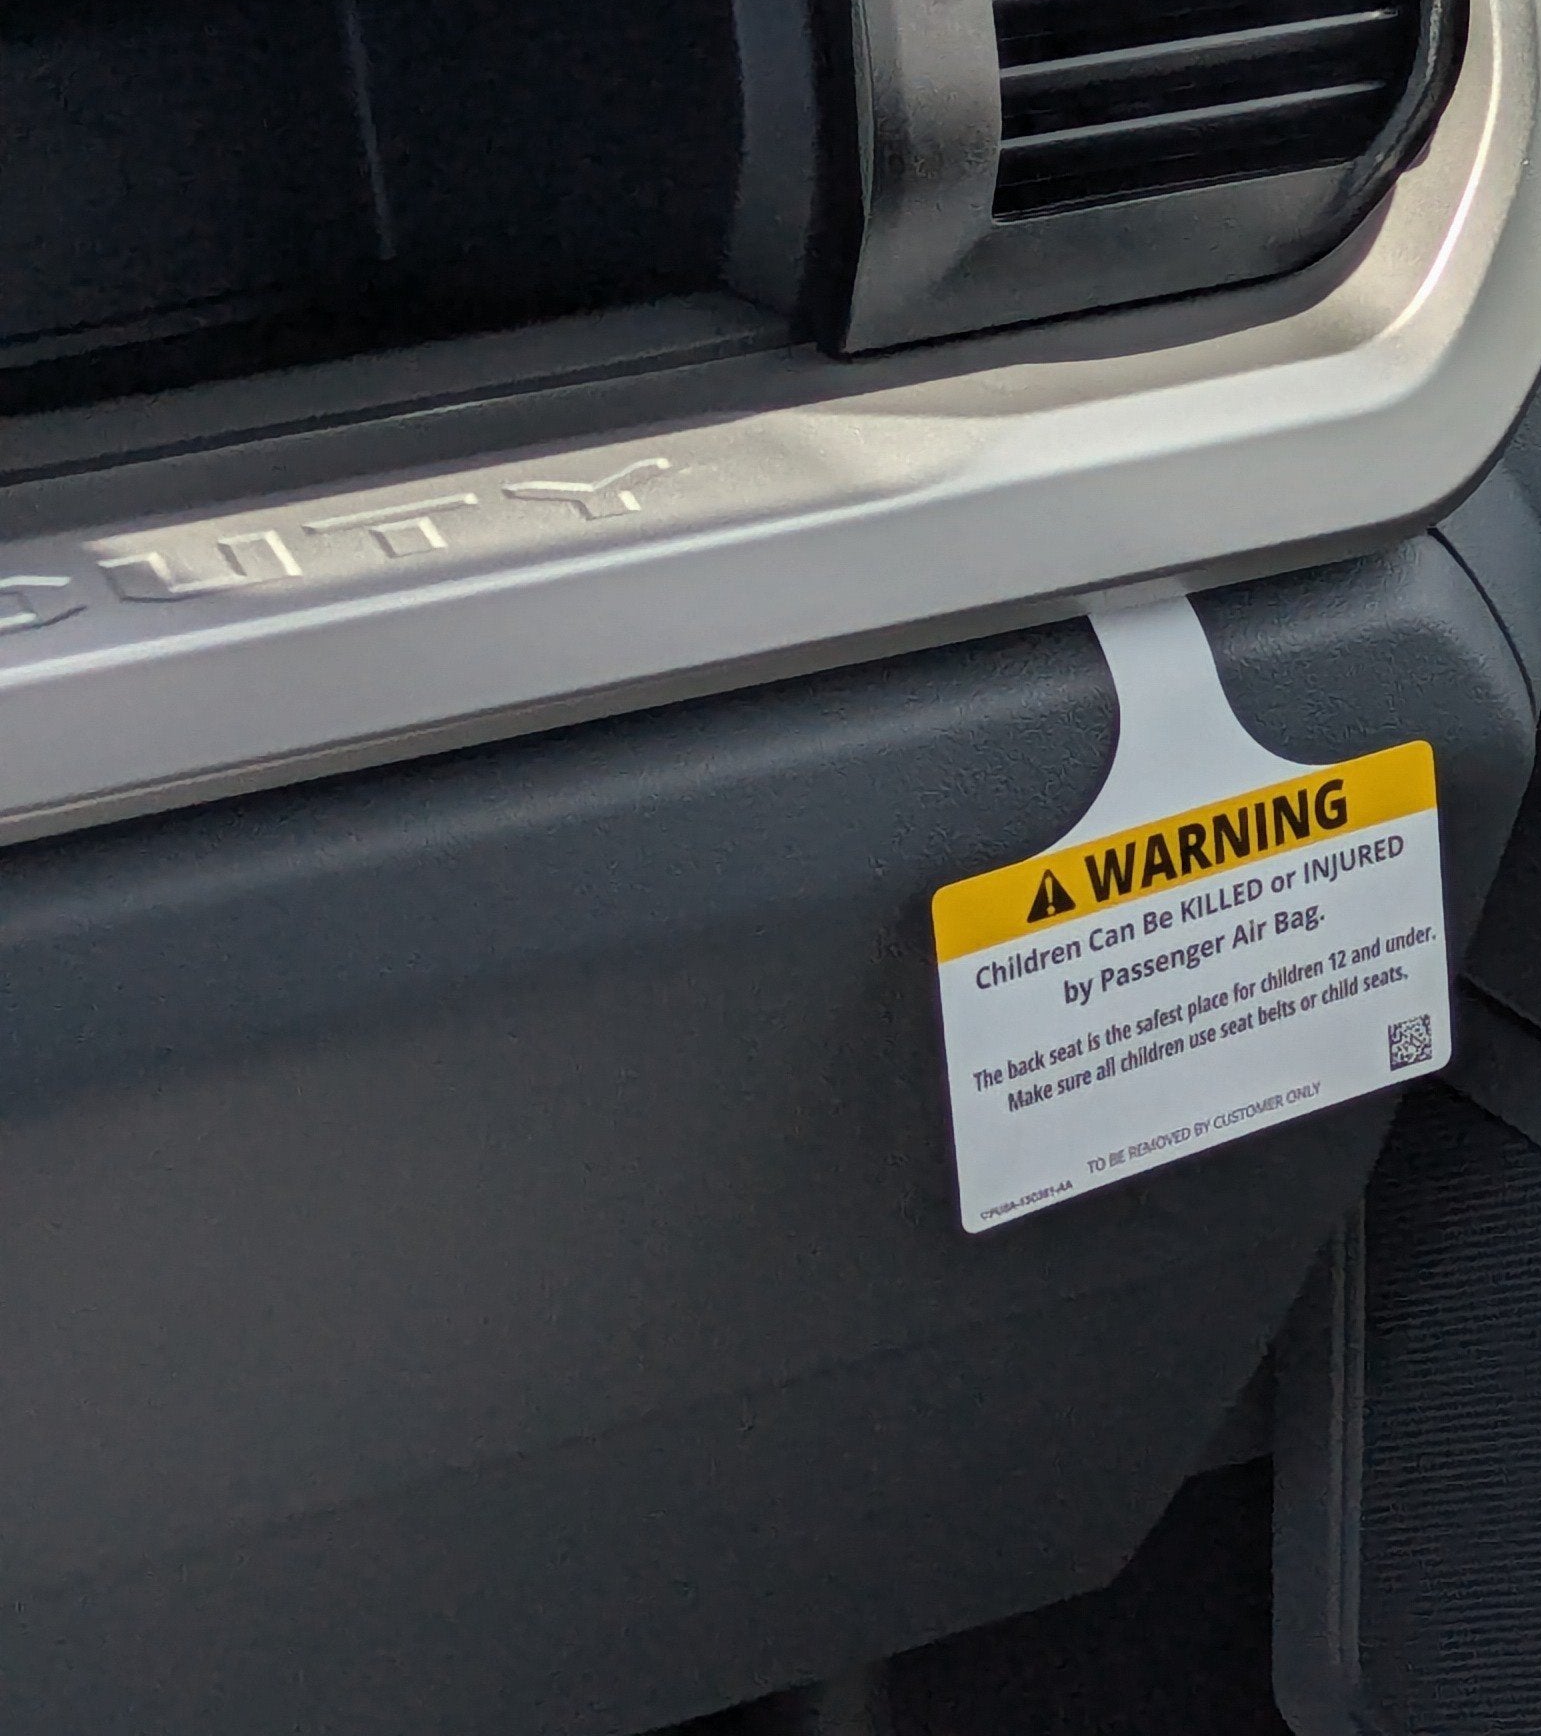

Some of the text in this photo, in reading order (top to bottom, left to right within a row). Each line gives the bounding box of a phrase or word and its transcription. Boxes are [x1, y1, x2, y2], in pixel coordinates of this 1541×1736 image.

[1084, 779, 1348, 902] WARNING
[976, 835, 1404, 989] Children Can Be KILLED or INJURED
[1063, 905, 1325, 1006] by Passenger Air Bag.
[972, 926, 1436, 1092] The back seat is the safest place for children 12 and under.
[1008, 1082, 1053, 1112] Make
[1057, 1069, 1092, 1095] sure
[1096, 1056, 1116, 1080] all
[1121, 1037, 1184, 1072] children
[1189, 1027, 1216, 1049] use
[1220, 1013, 1254, 1038] seat
[1258, 999, 1296, 1025] belts
[1301, 993, 1318, 1011] or
[1321, 978, 1358, 1004] child
[1087, 1080, 1321, 1174] TO BE REMOVED BY CUSTOMER ONLY
